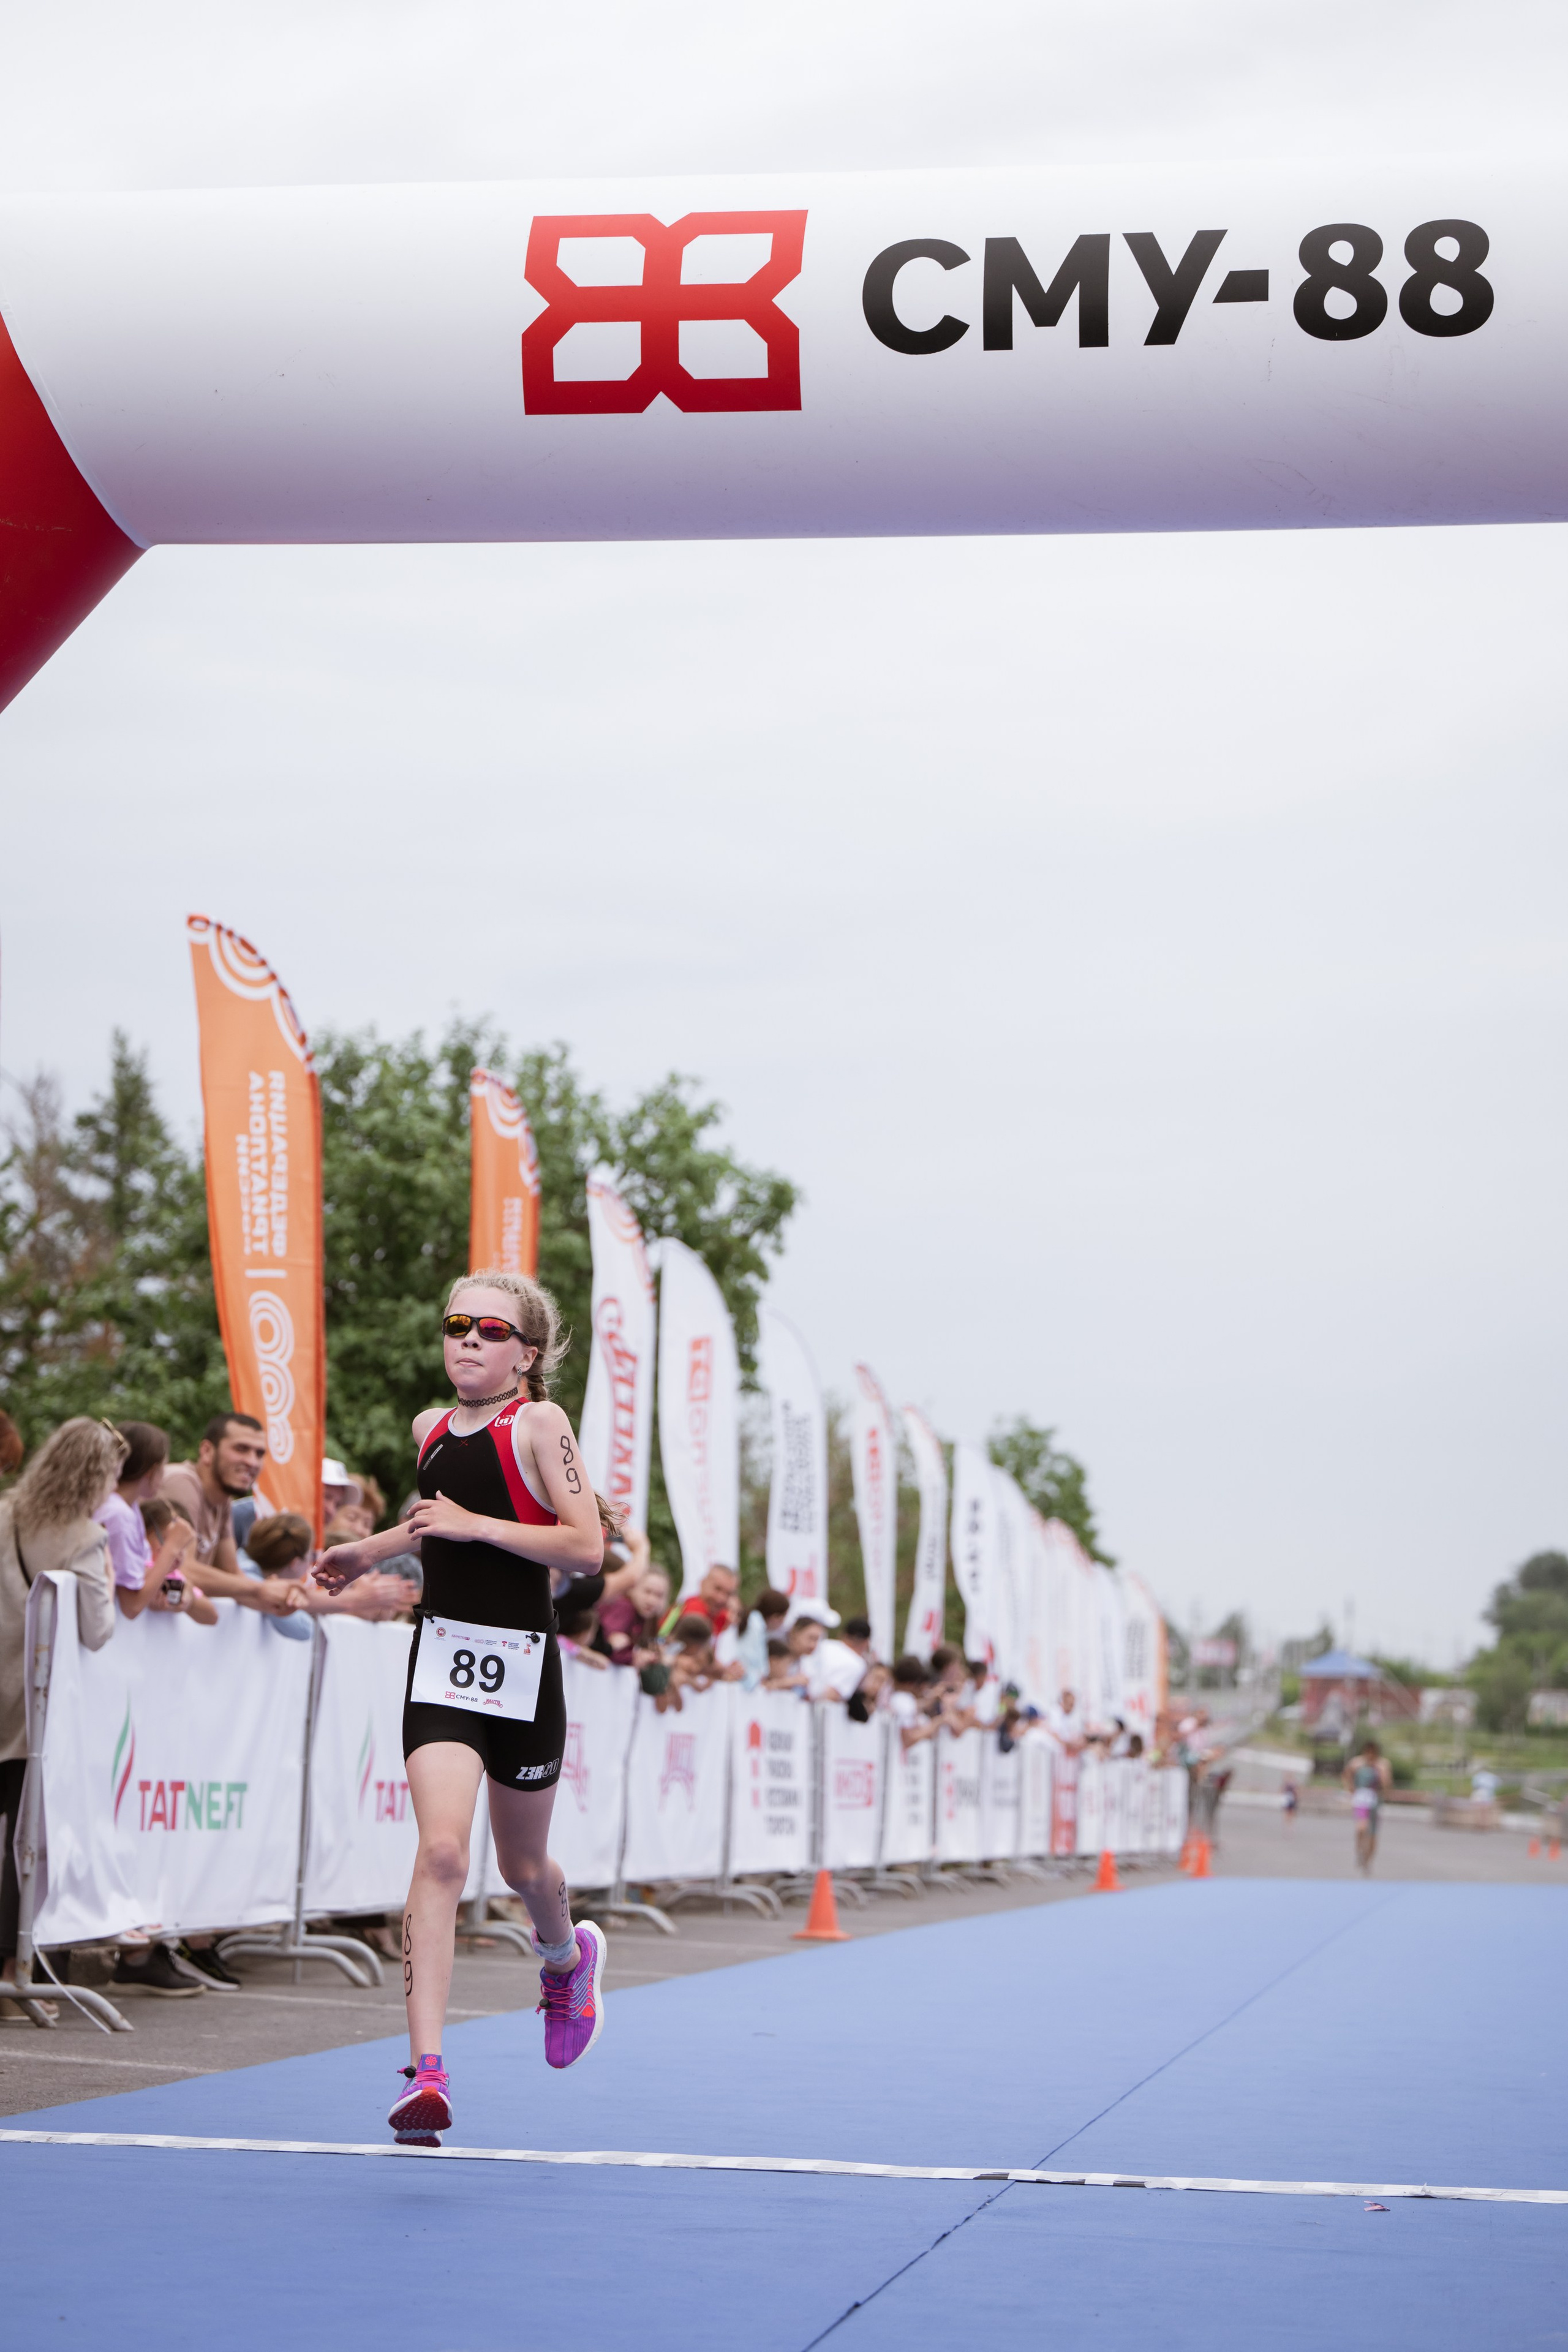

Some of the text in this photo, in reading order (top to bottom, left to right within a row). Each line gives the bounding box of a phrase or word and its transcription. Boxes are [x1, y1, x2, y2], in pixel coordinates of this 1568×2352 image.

[862, 219, 1494, 355] СМУ-88
[449, 1649, 505, 1693] 89
[456, 1694, 478, 1703] СМУ-88
[138, 1780, 249, 1831] TATNEFT
